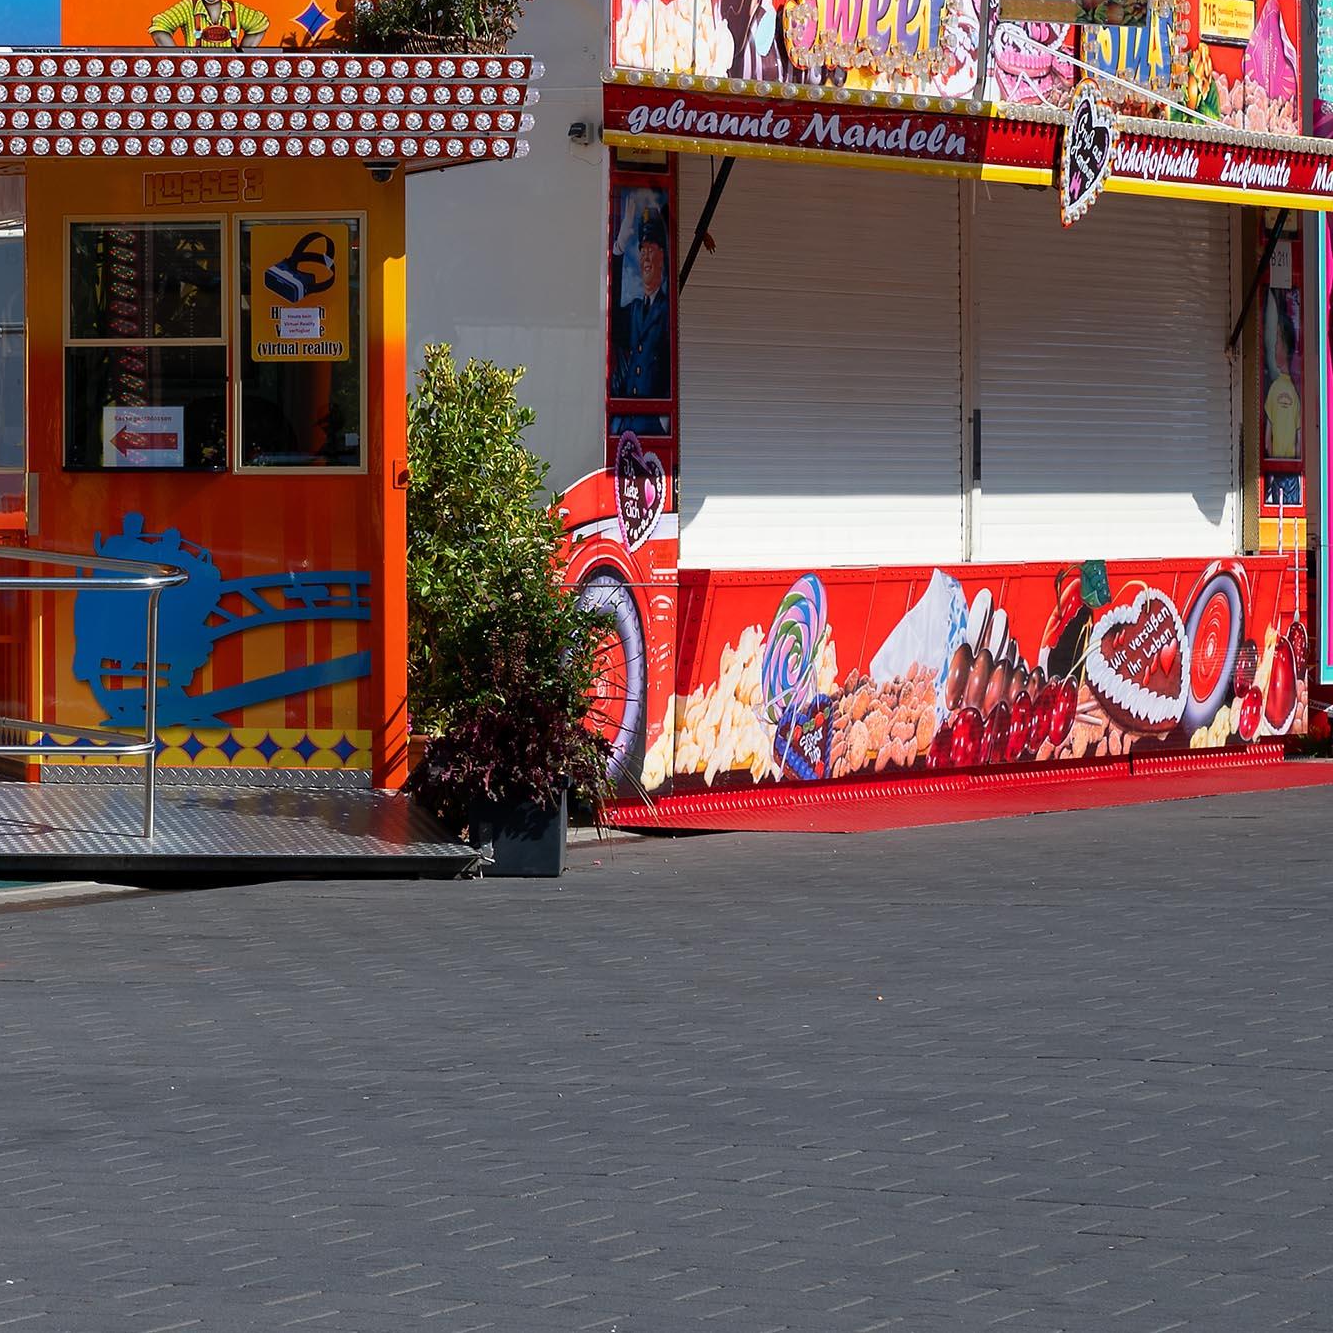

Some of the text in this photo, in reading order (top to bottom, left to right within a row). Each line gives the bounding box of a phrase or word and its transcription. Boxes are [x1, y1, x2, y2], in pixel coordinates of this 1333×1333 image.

[1204, 3, 1216, 26] 715
[627, 99, 966, 155] gebrannte Mandeln
[242, 169, 264, 202] 3
[1114, 143, 1199, 181] Schokofrüchte
[1220, 153, 1291, 190] Zuckerwatte
[257, 342, 343, 356] (virtual reality)
[1111, 607, 1171, 670] Wir versüßen
[1127, 629, 1173, 676] Ihr Leben
